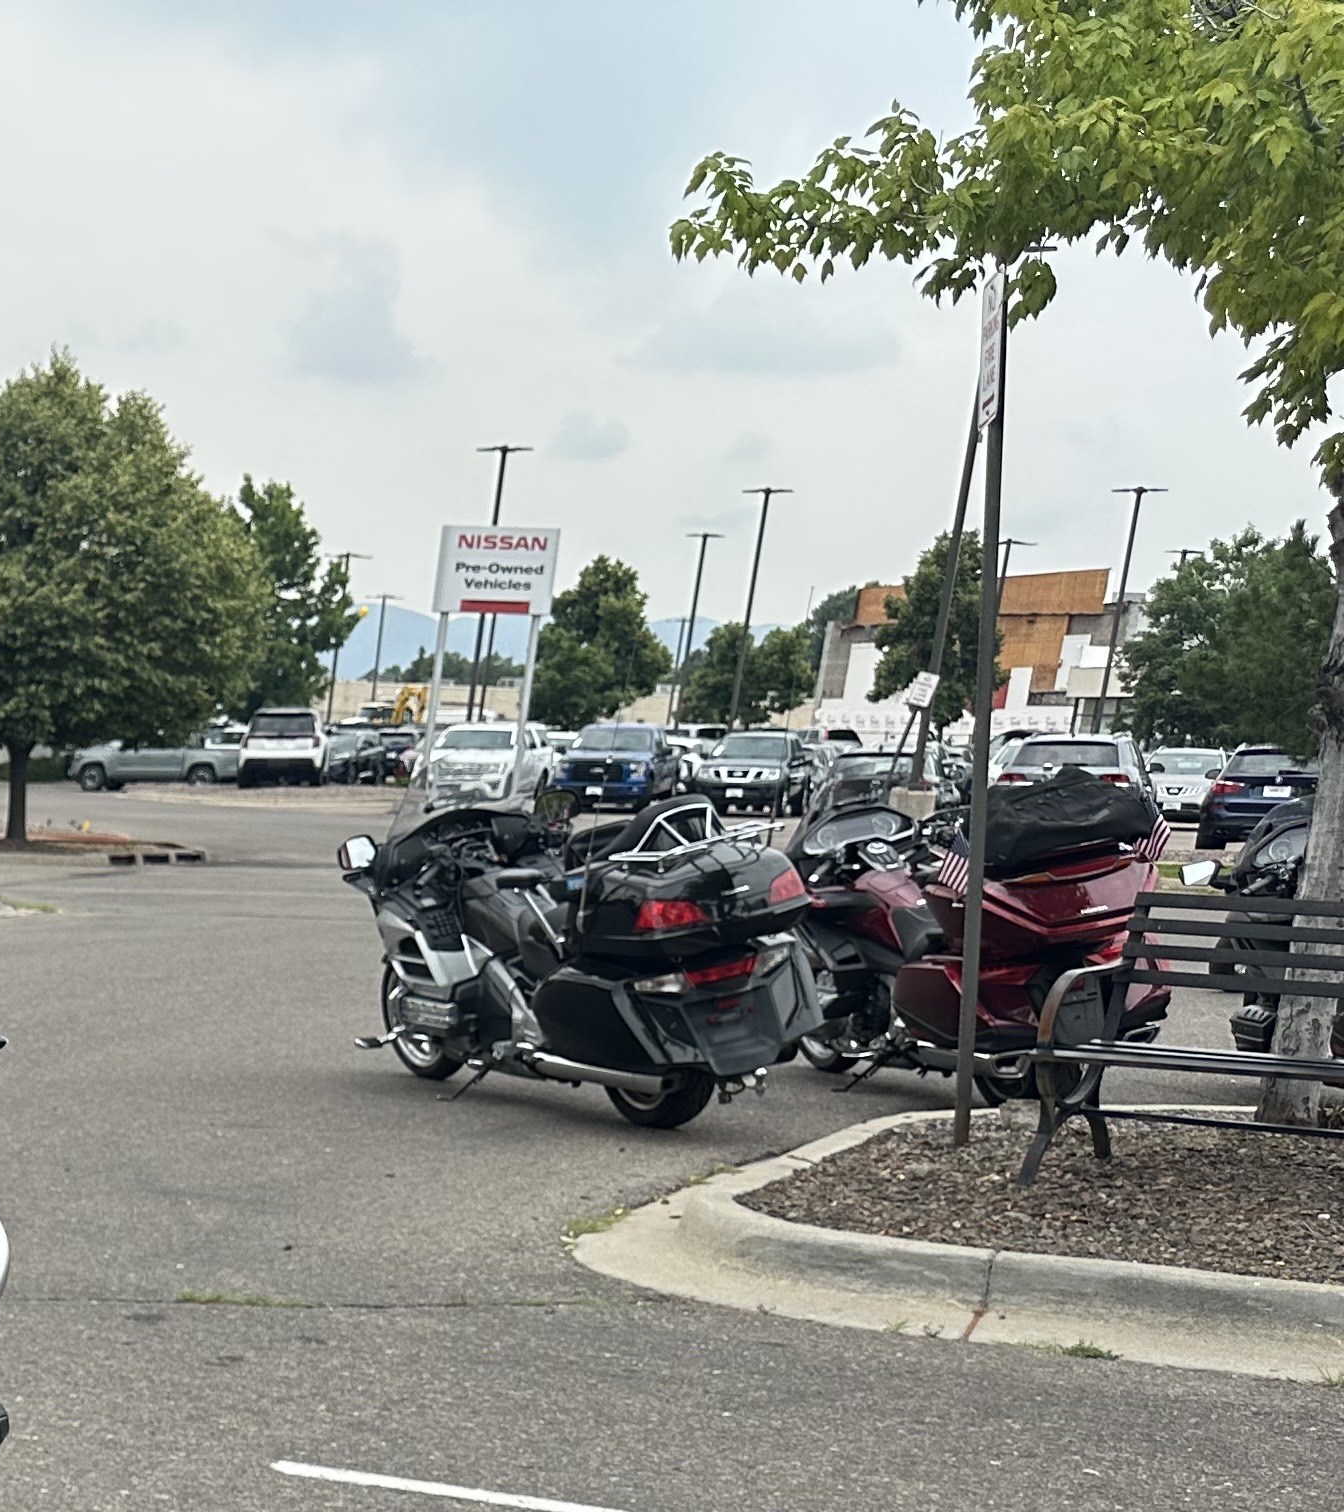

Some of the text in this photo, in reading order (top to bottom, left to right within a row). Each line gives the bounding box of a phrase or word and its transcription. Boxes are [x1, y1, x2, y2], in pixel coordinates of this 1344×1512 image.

[457, 534, 548, 551] NISSAN
[455, 561, 545, 575] Pre-Owned
[464, 578, 532, 591] Vehicles
